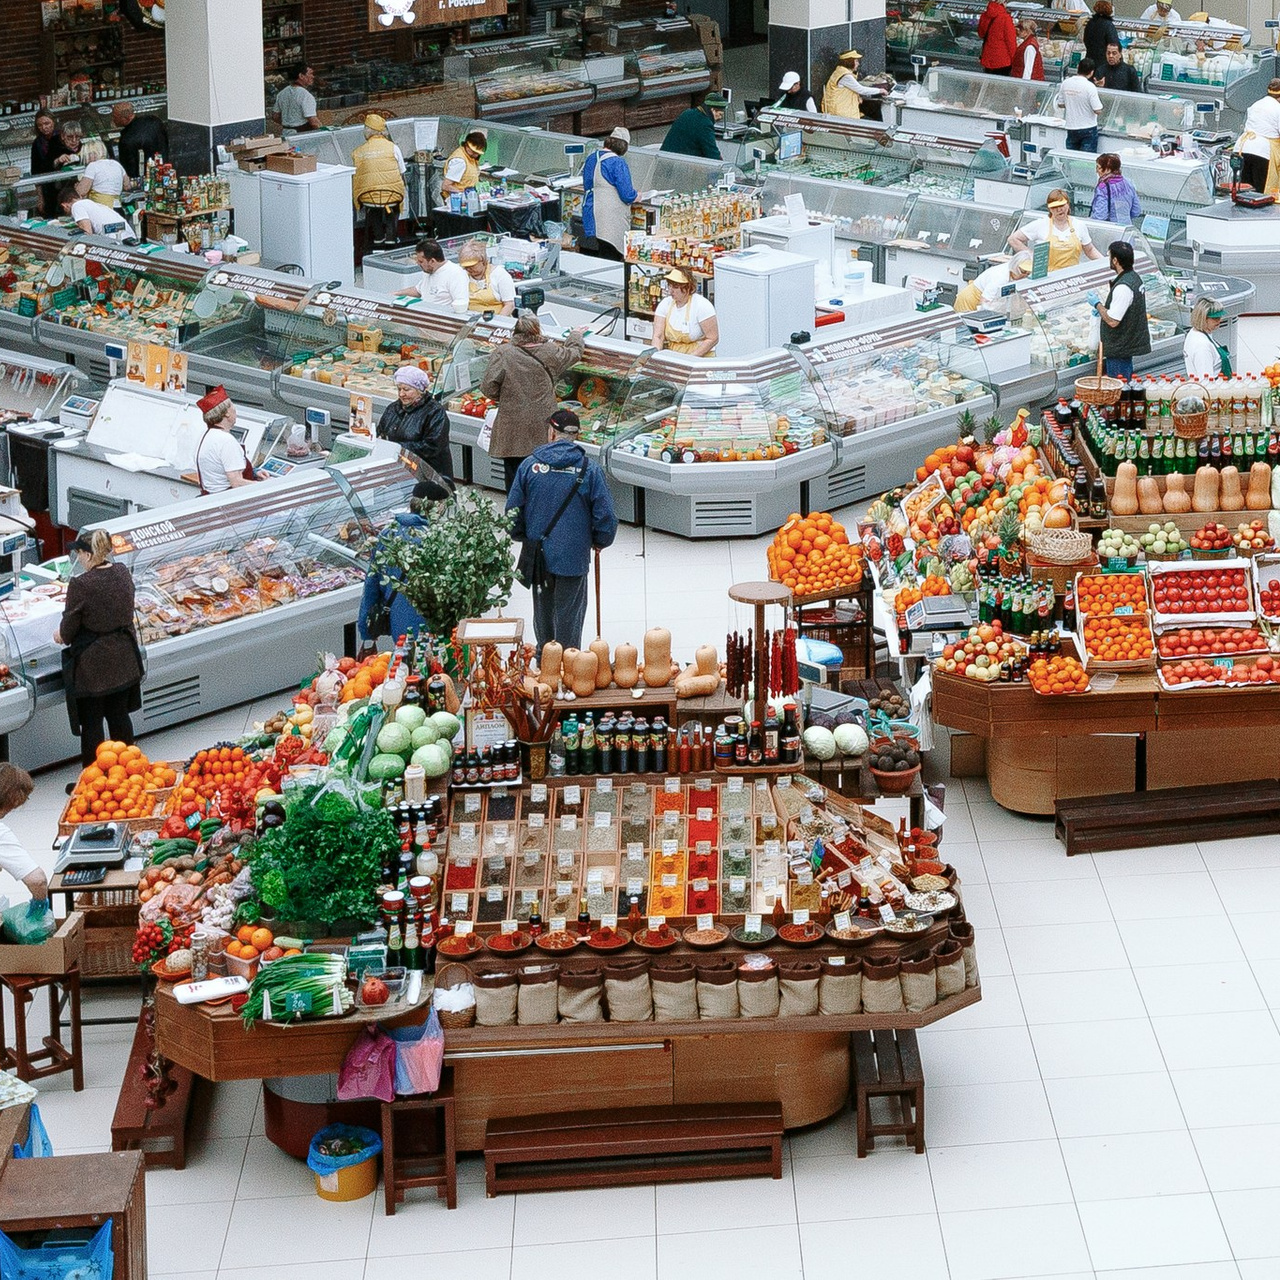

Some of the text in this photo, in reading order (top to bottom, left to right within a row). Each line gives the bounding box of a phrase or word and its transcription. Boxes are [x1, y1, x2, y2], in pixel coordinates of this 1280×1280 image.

[438, 0, 446, 9] г.
[130, 520, 176, 543] ДОНСКОЙ
[476, 722, 505, 731] ДИПЛОМ
